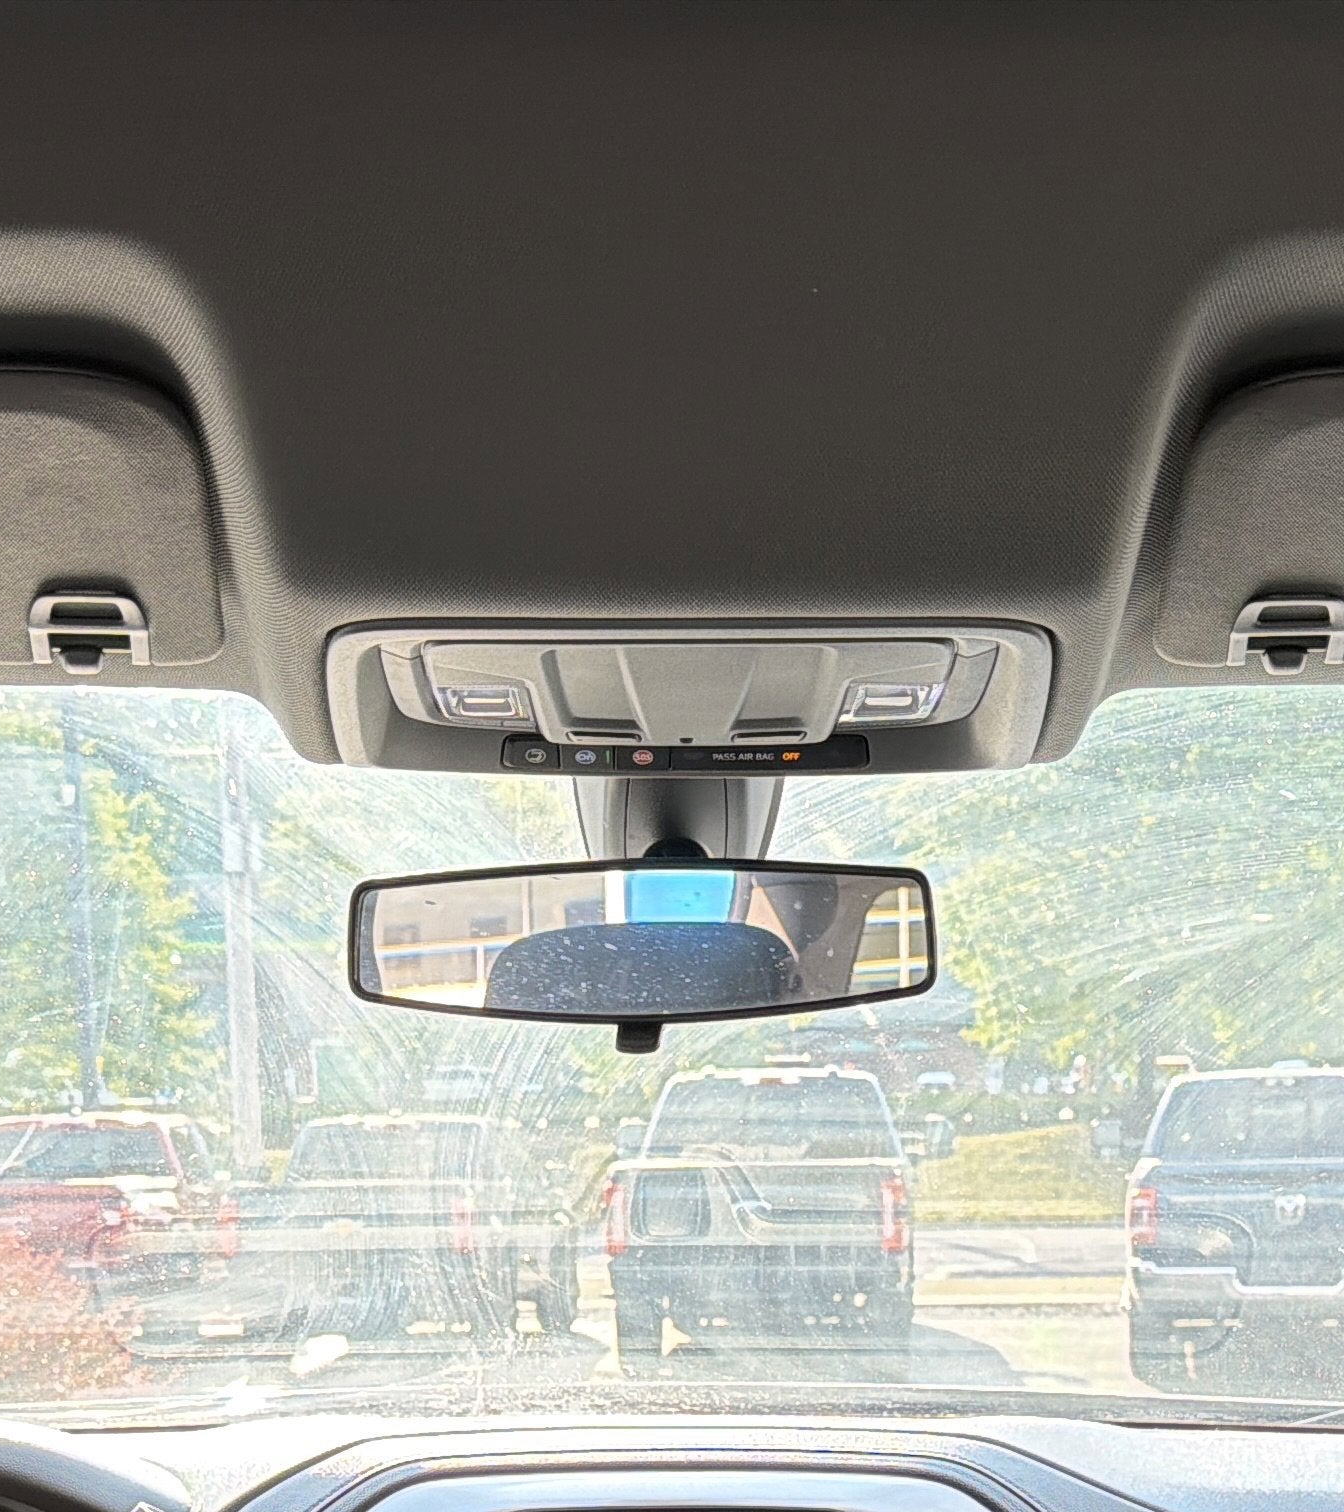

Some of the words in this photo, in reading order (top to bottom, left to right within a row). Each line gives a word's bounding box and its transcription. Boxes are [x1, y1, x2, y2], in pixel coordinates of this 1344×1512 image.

[634, 753, 652, 761] SOS
[712, 753, 736, 761] PASS
[737, 753, 753, 761] AIR
[756, 753, 774, 761] BAG
[782, 753, 800, 761] OFF
